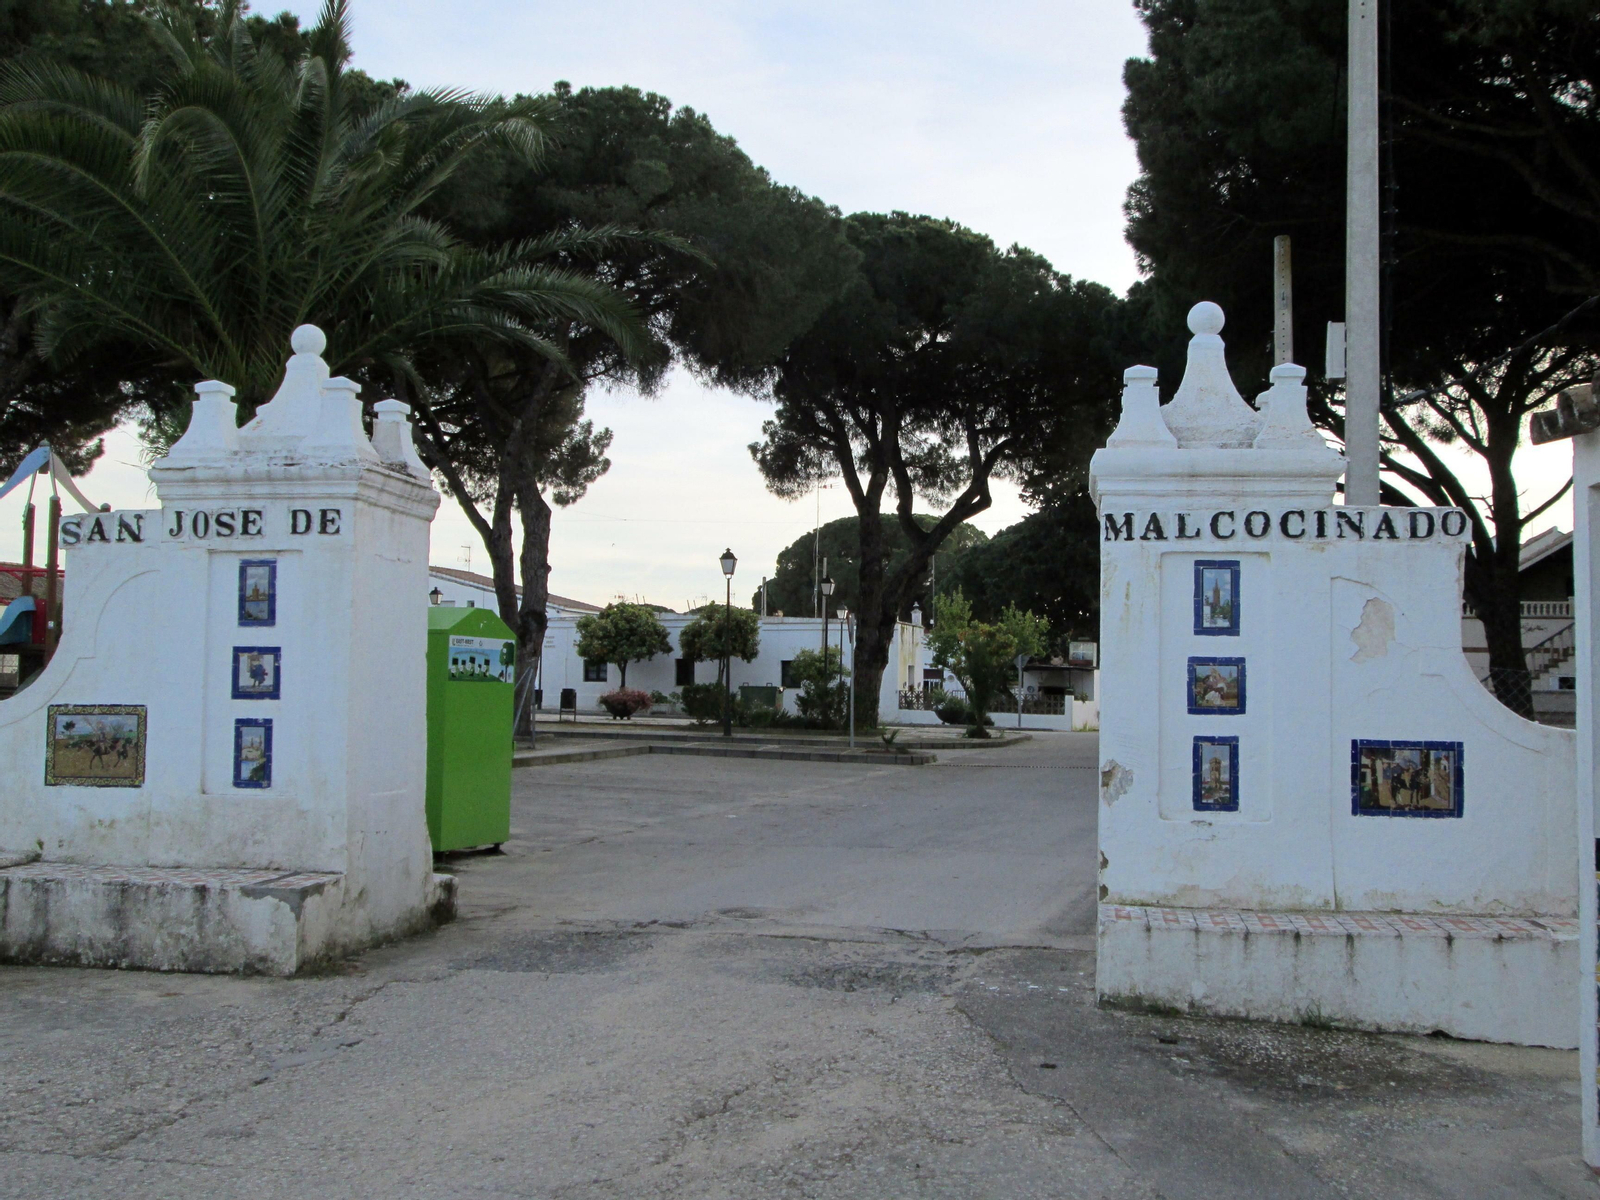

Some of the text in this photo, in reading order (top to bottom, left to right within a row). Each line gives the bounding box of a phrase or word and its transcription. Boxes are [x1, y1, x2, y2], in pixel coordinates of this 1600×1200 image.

[61, 508, 341, 545] SAN JOSE DE
[1104, 510, 1468, 541] MALCOCINADO
